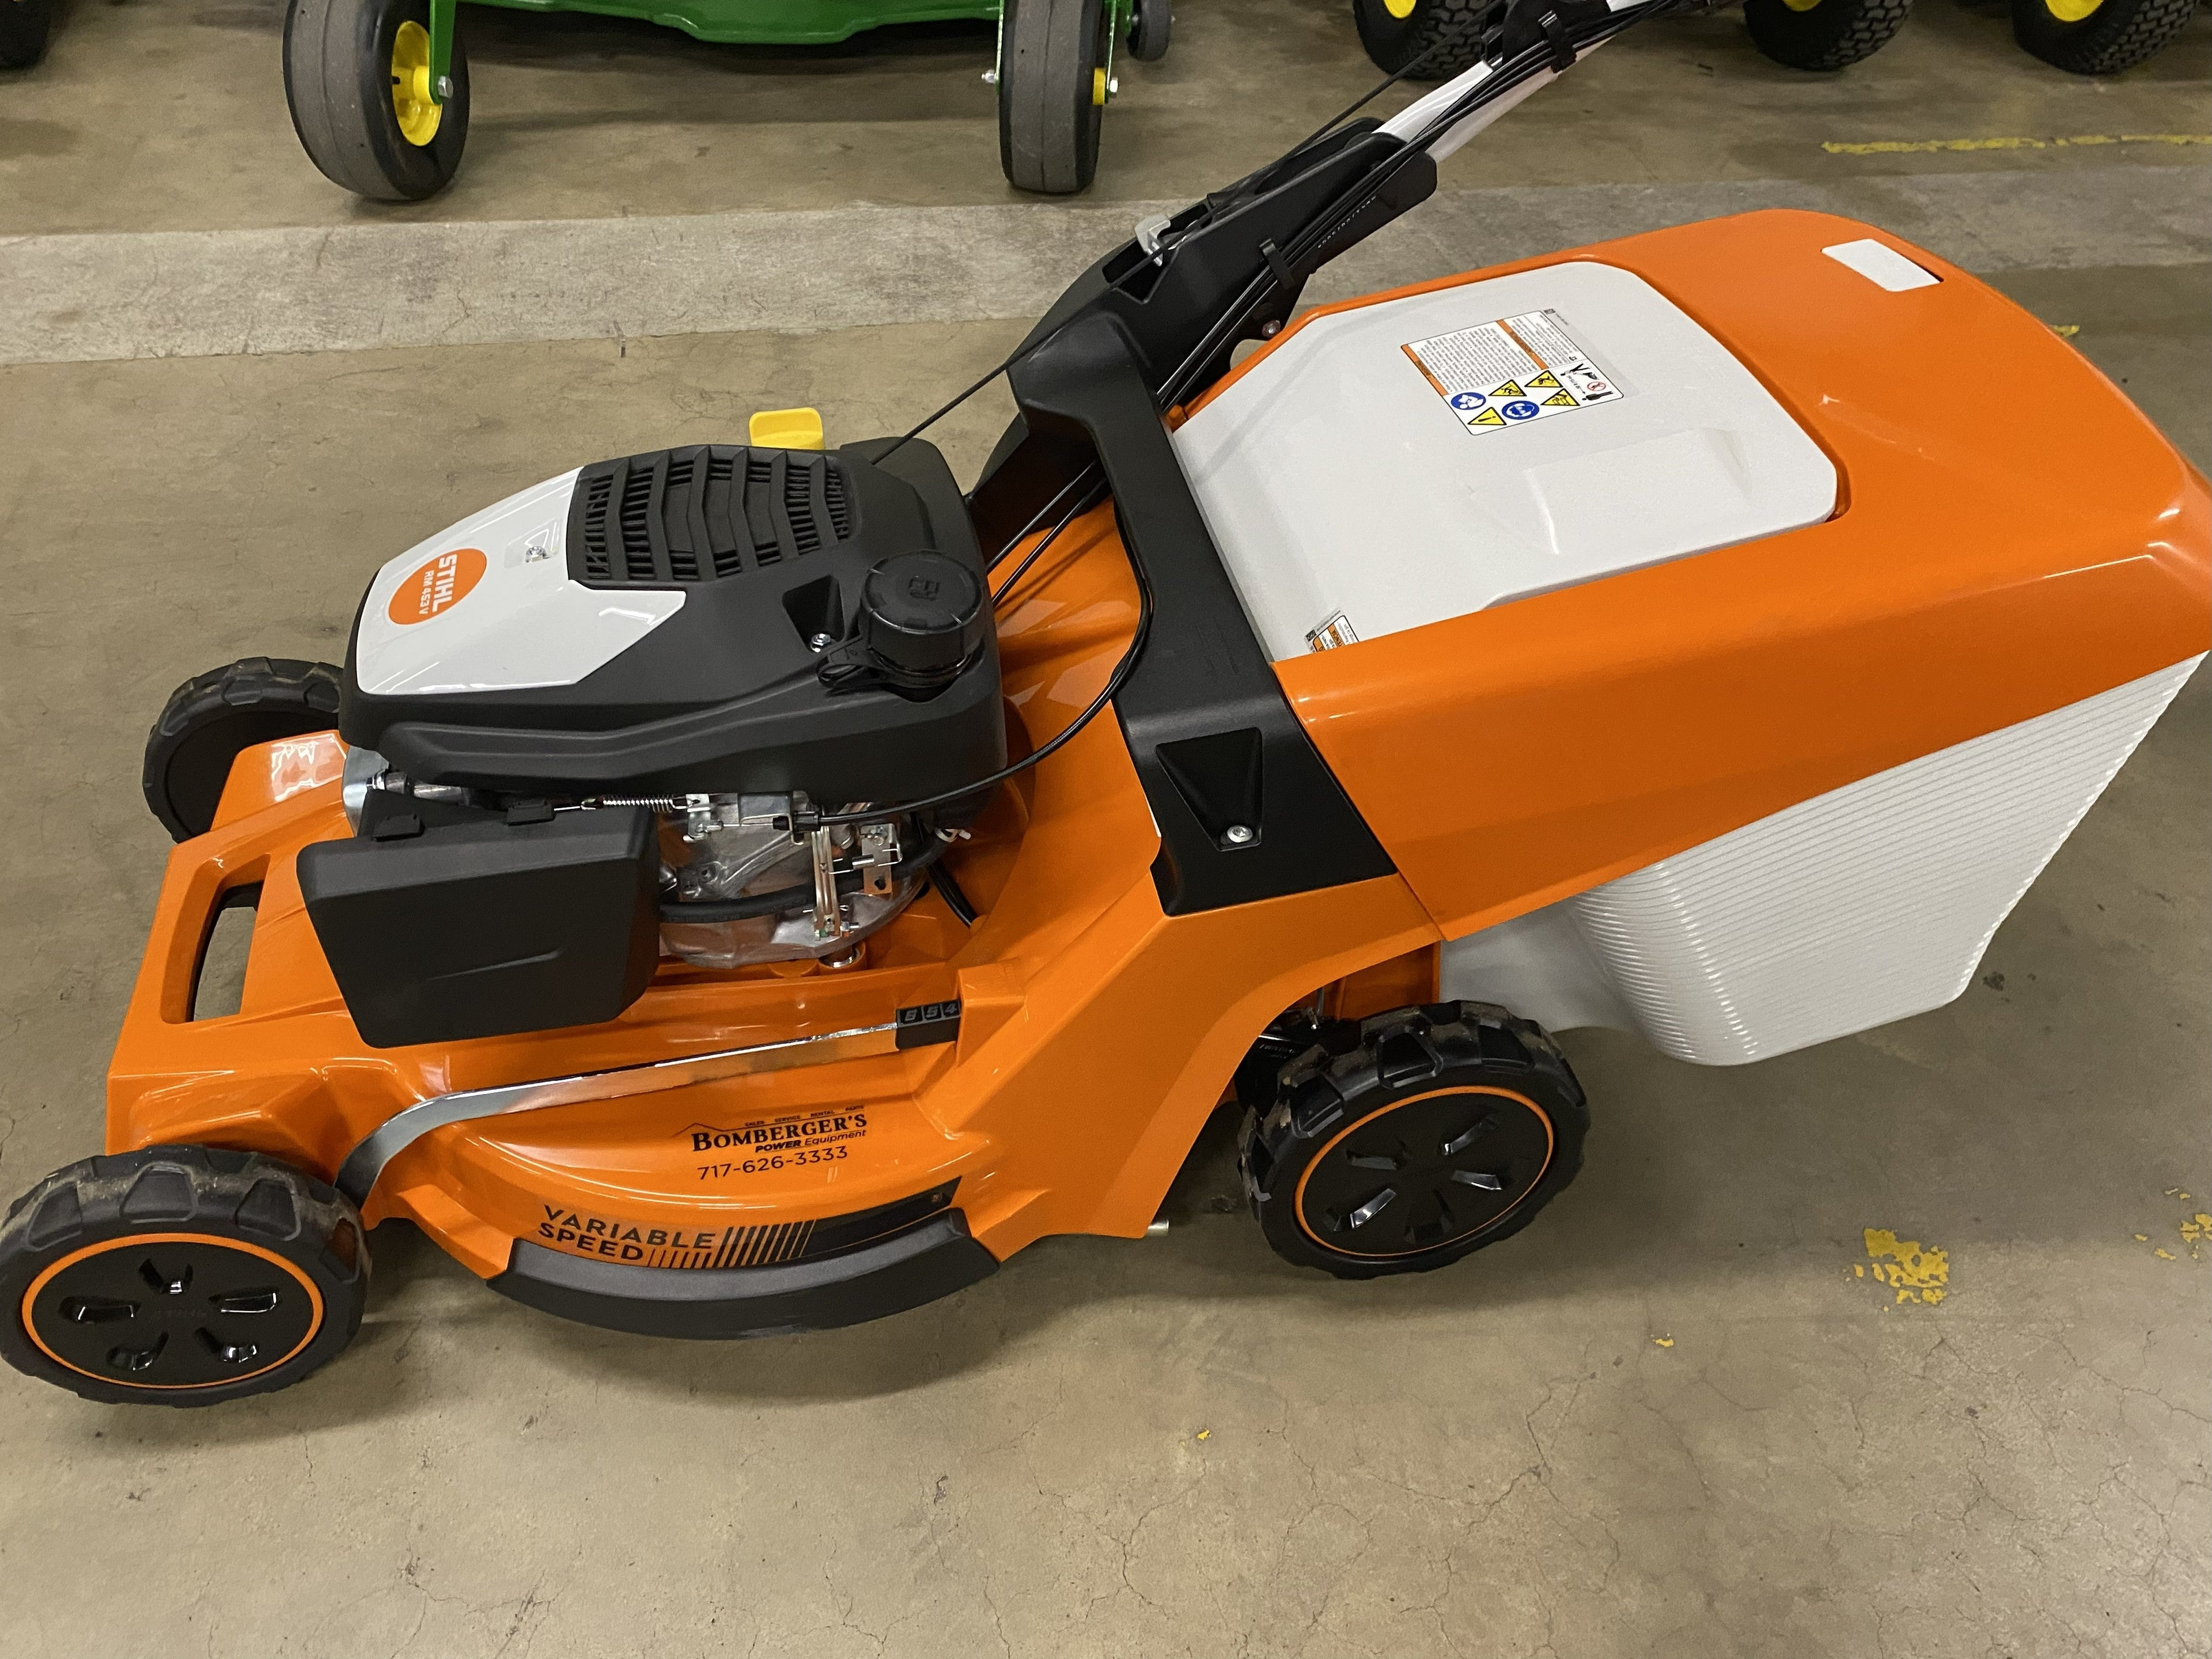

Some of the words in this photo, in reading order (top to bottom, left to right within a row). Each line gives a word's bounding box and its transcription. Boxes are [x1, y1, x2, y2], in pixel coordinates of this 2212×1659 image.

[423, 570, 434, 587] RM
[431, 554, 458, 612] STIHL
[420, 588, 431, 608] 453
[925, 1005, 938, 1018] 5
[945, 1003, 957, 1014] 4
[774, 1115, 801, 1123] SERVICE
[755, 1139, 801, 1153] POWER
[805, 1130, 867, 1146] Equipment
[697, 1145, 848, 1180] 717-626-3333
[544, 1204, 715, 1249] VARIABLE
[537, 1222, 643, 1260] SPEED
